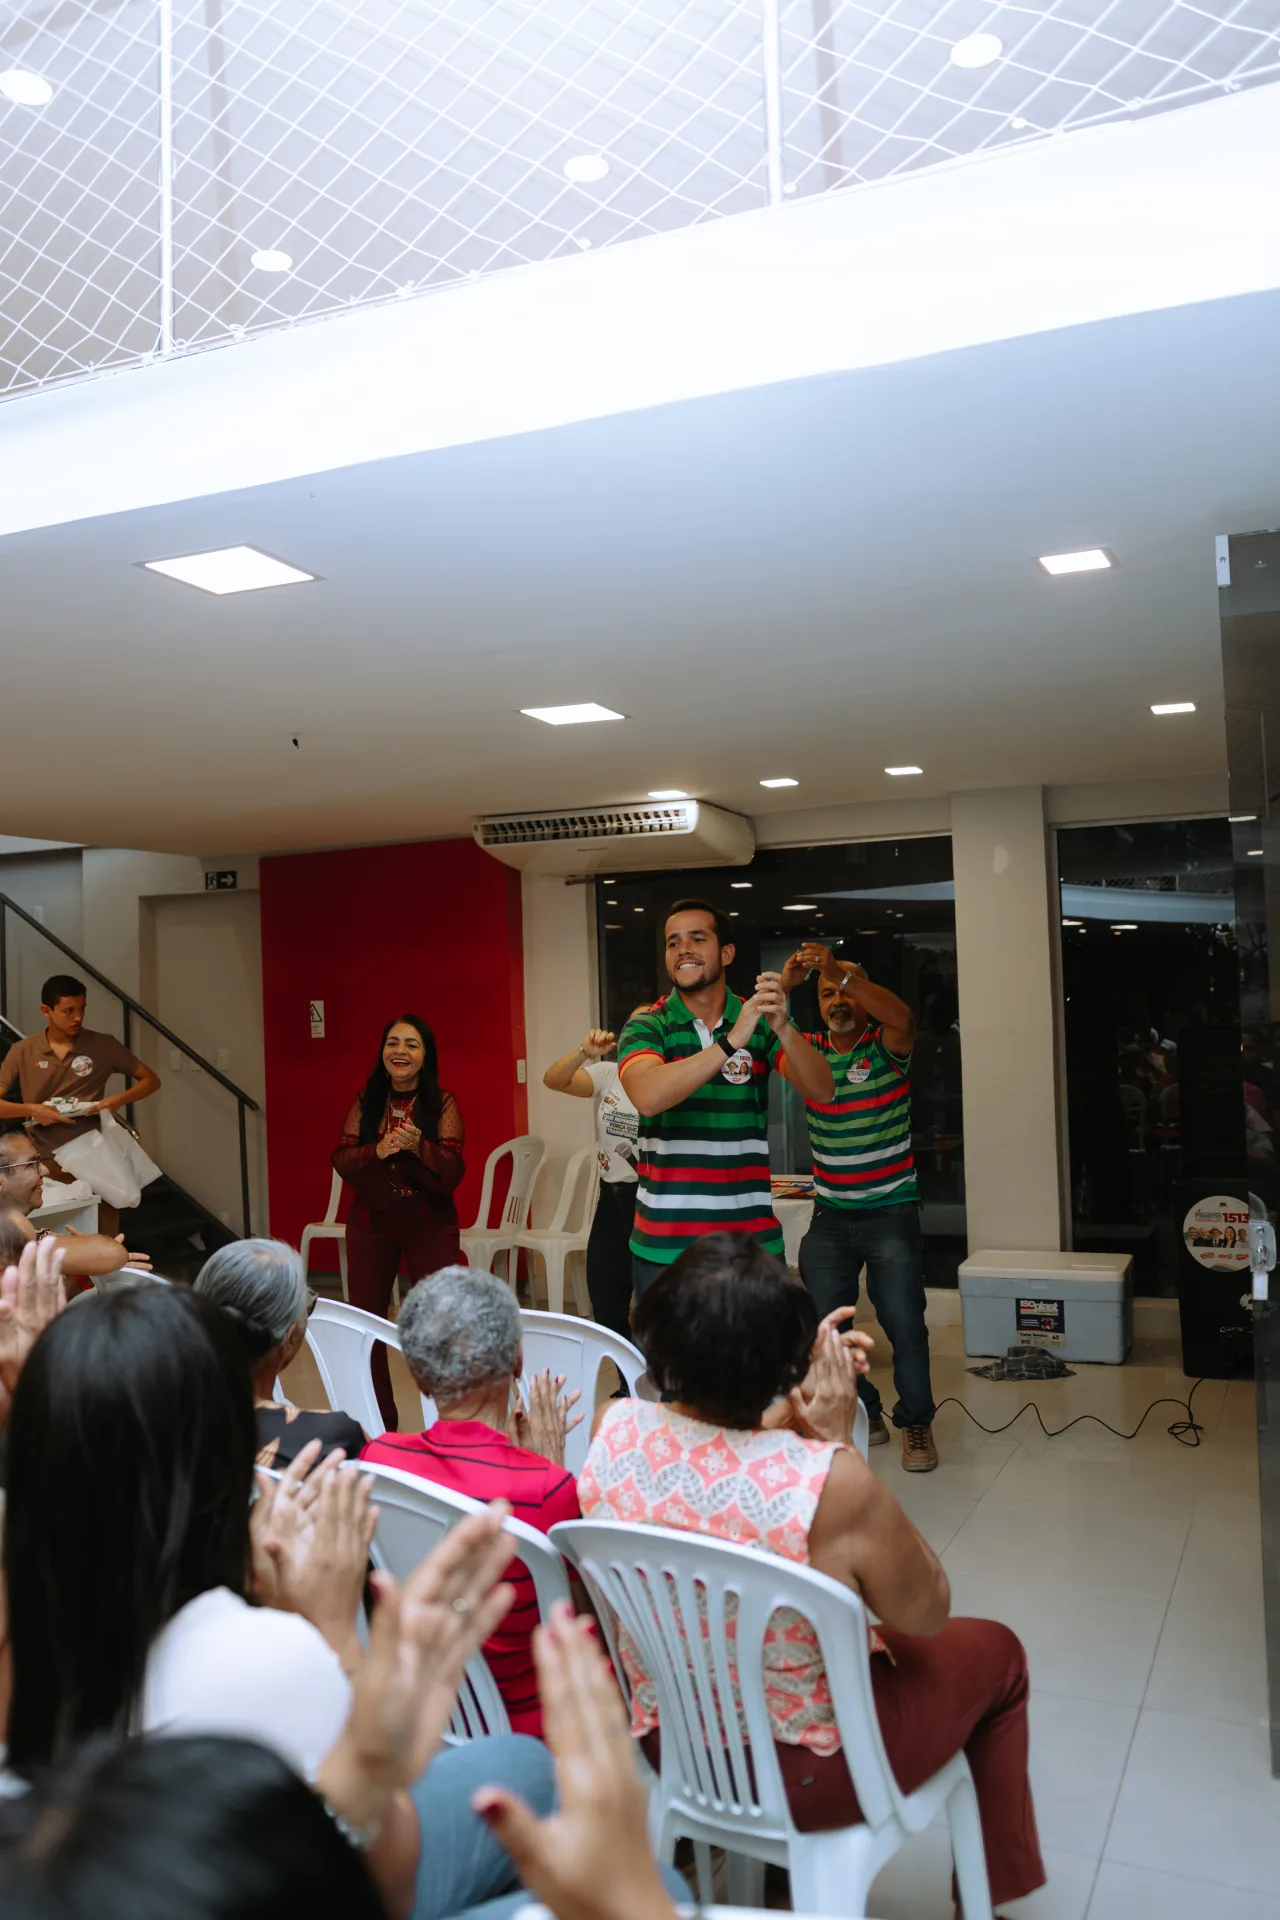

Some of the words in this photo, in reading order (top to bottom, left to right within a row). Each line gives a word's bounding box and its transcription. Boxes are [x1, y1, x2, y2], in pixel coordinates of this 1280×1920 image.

[610, 1122, 625, 1131] FORÇA
[614, 1117, 639, 1126] REPRESEN
[607, 1128, 638, 1139] TRANSFORM
[1223, 1212, 1249, 1223] 1513
